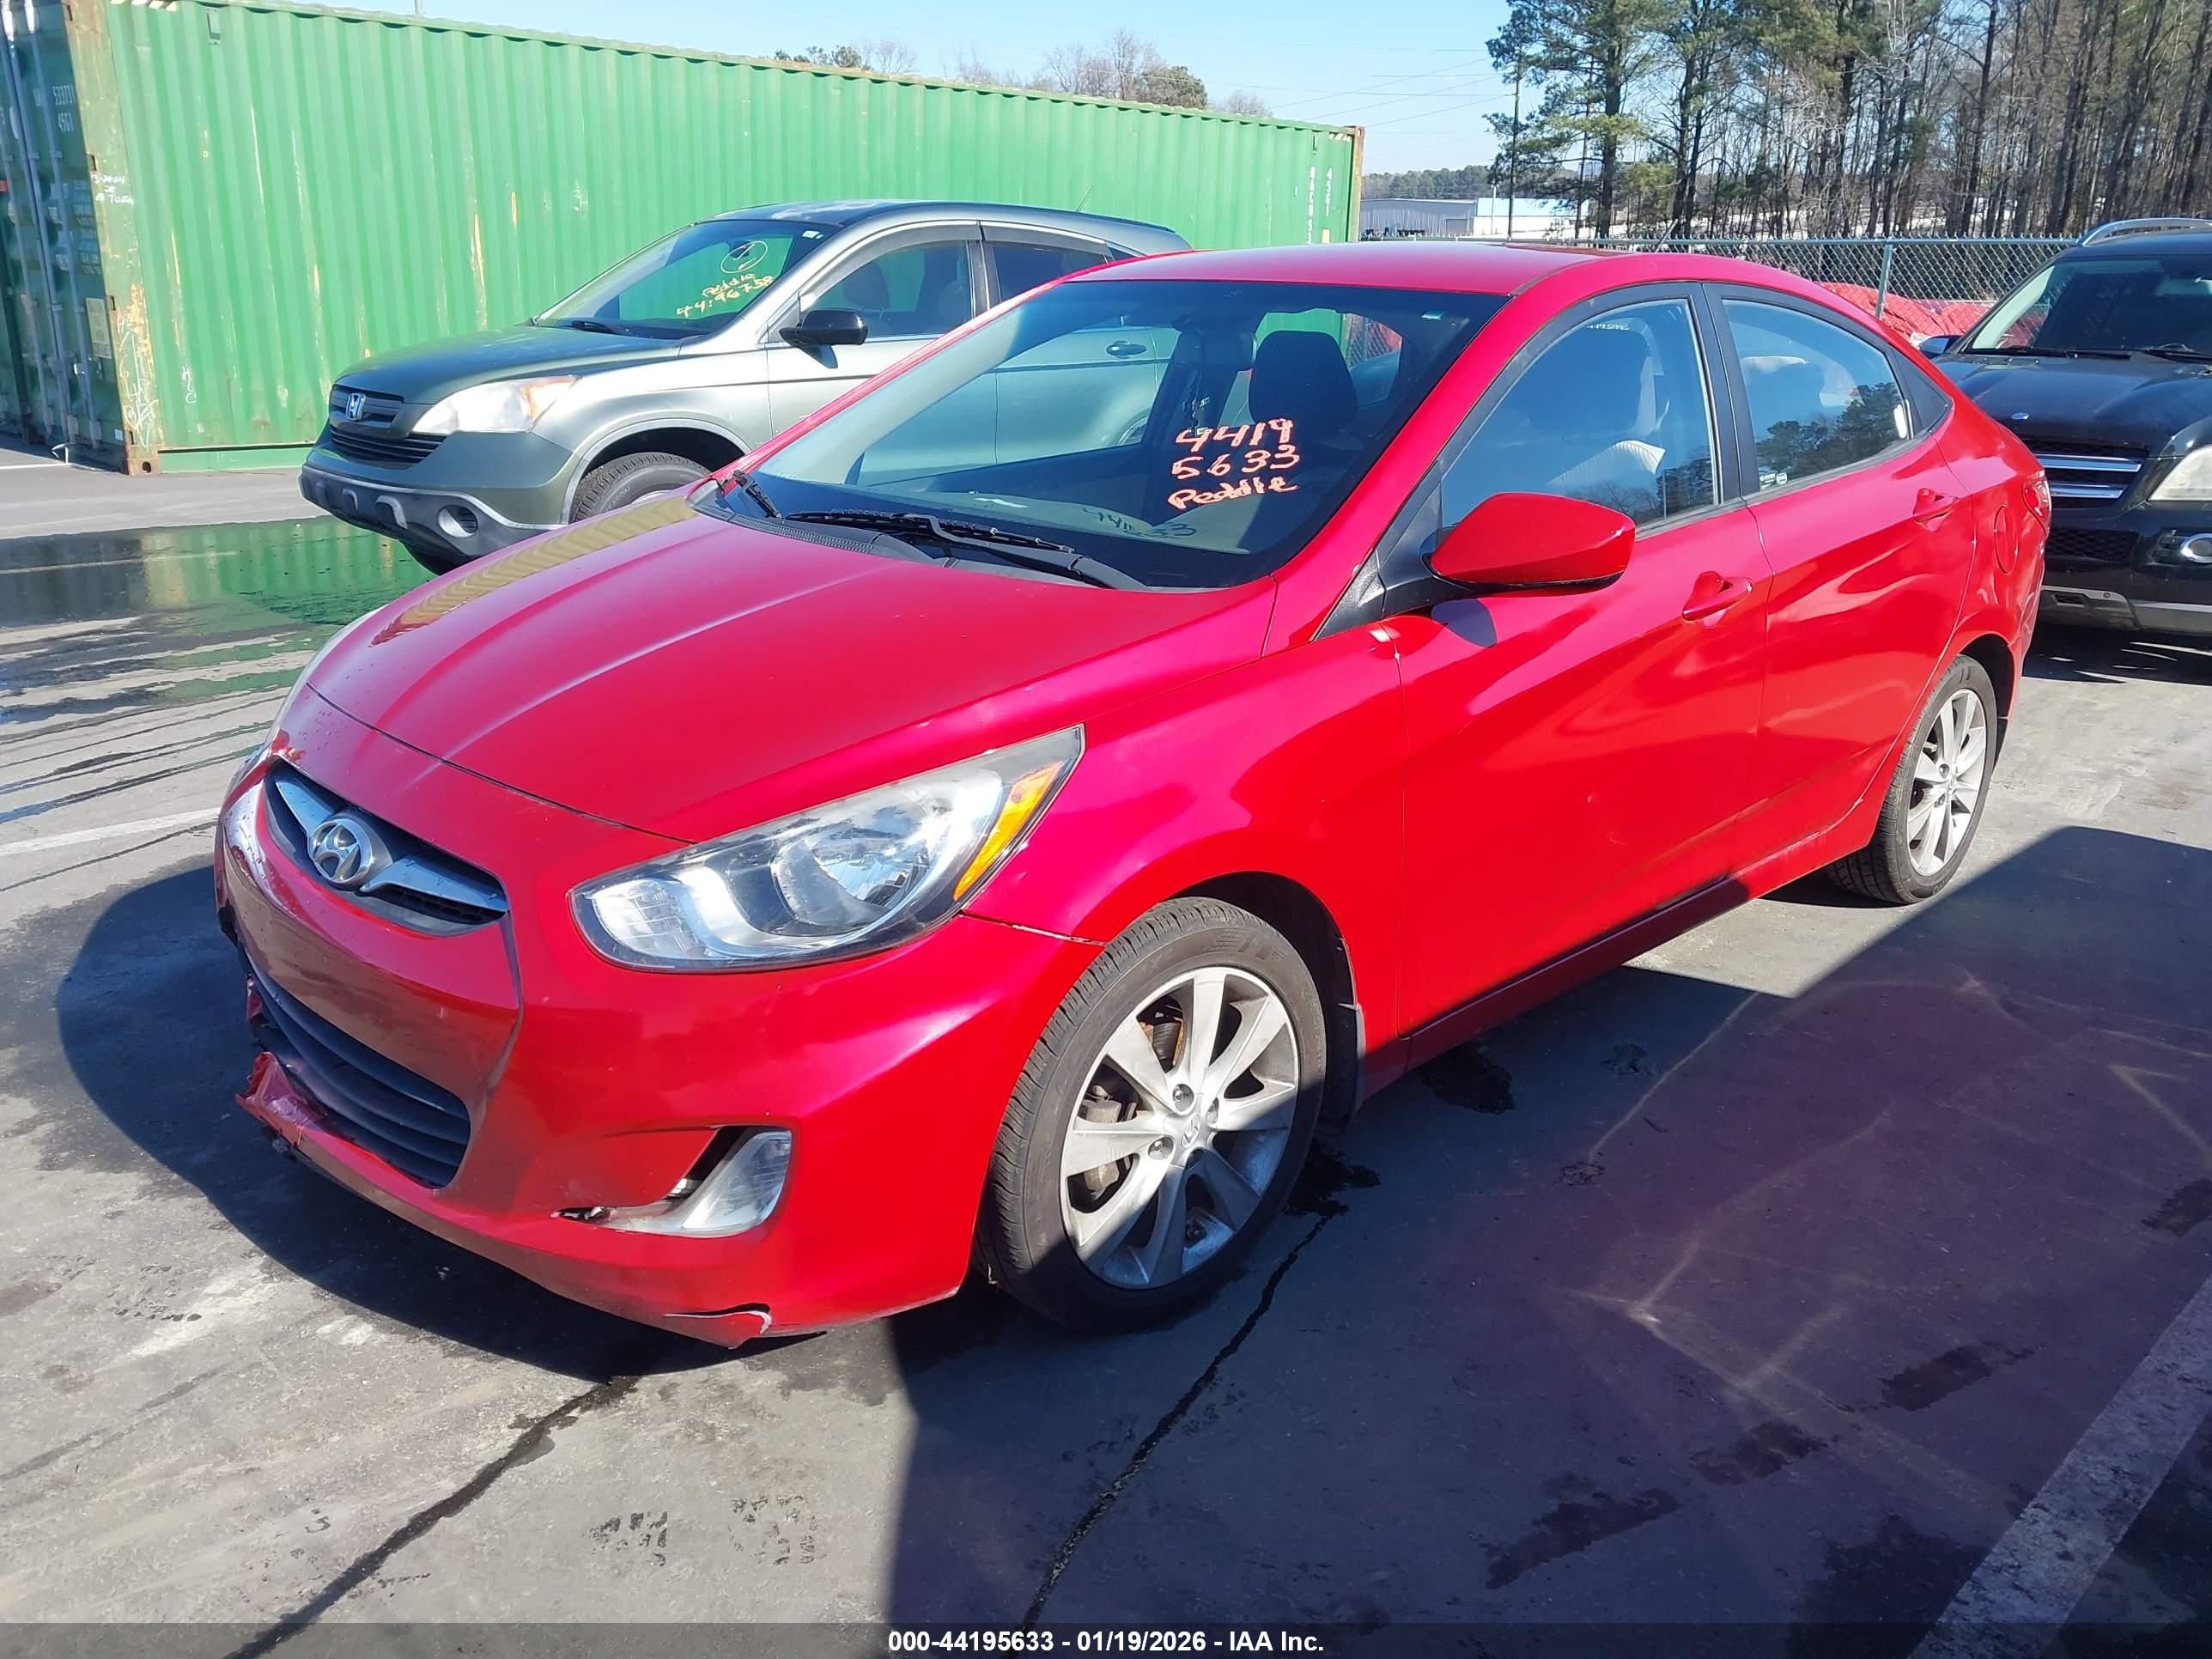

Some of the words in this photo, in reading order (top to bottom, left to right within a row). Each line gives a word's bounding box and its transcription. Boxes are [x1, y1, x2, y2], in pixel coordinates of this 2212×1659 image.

[1175, 417, 1294, 453] 4419
[1171, 444, 1301, 479] 5633
[1167, 476, 1299, 509] Peddle
